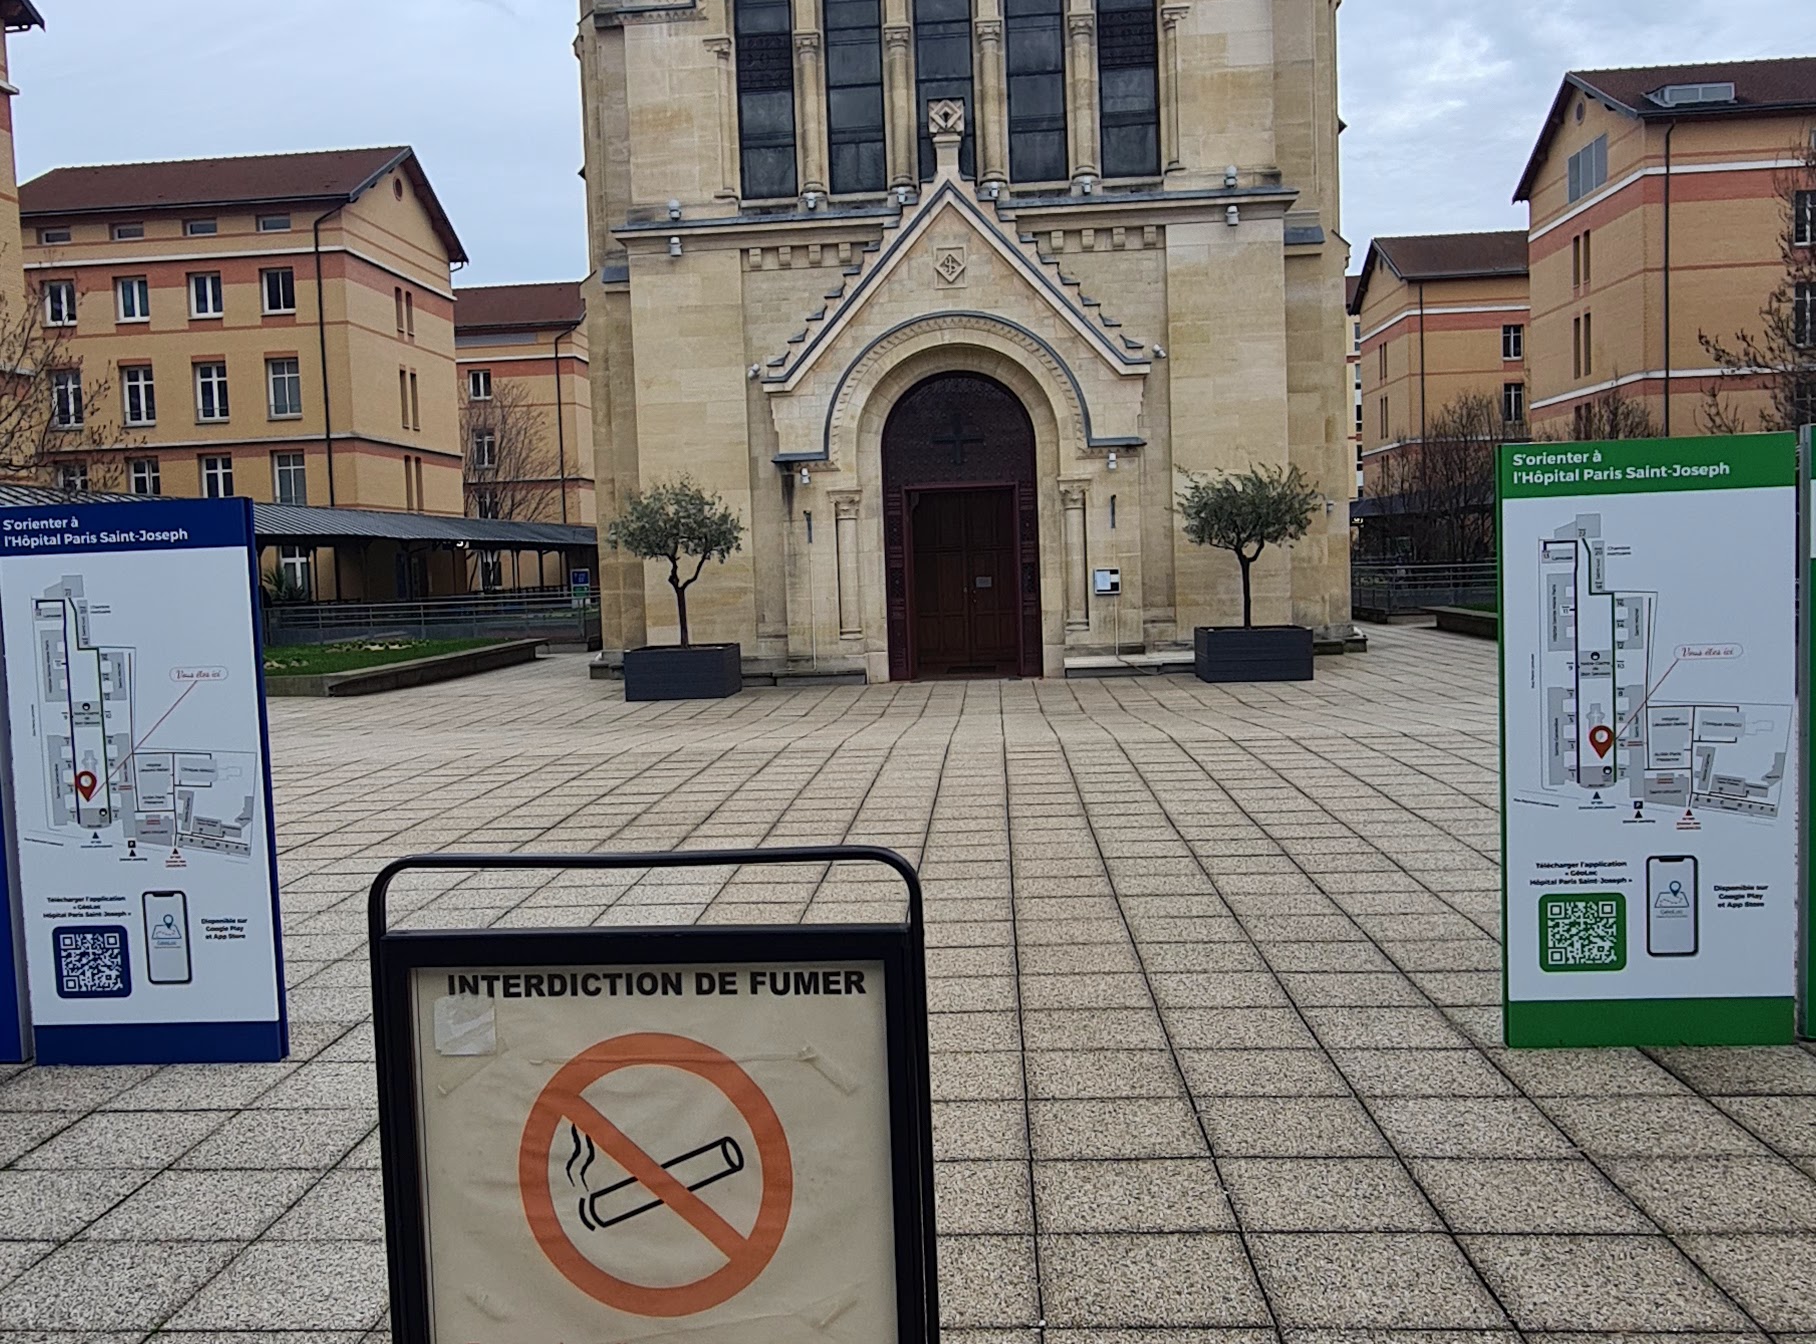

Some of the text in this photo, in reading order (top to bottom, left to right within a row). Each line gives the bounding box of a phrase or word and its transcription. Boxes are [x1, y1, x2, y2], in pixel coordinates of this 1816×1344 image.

[1512, 449, 1602, 466] S'orienter à
[1513, 461, 1730, 486] l'Hôpital Paris Saint-Joseph
[3, 516, 79, 530] S'orienter à
[4, 528, 188, 549] l'Hôpital Paris Saint-Joseph
[448, 970, 866, 998] INTERDICTION DE FUMER
